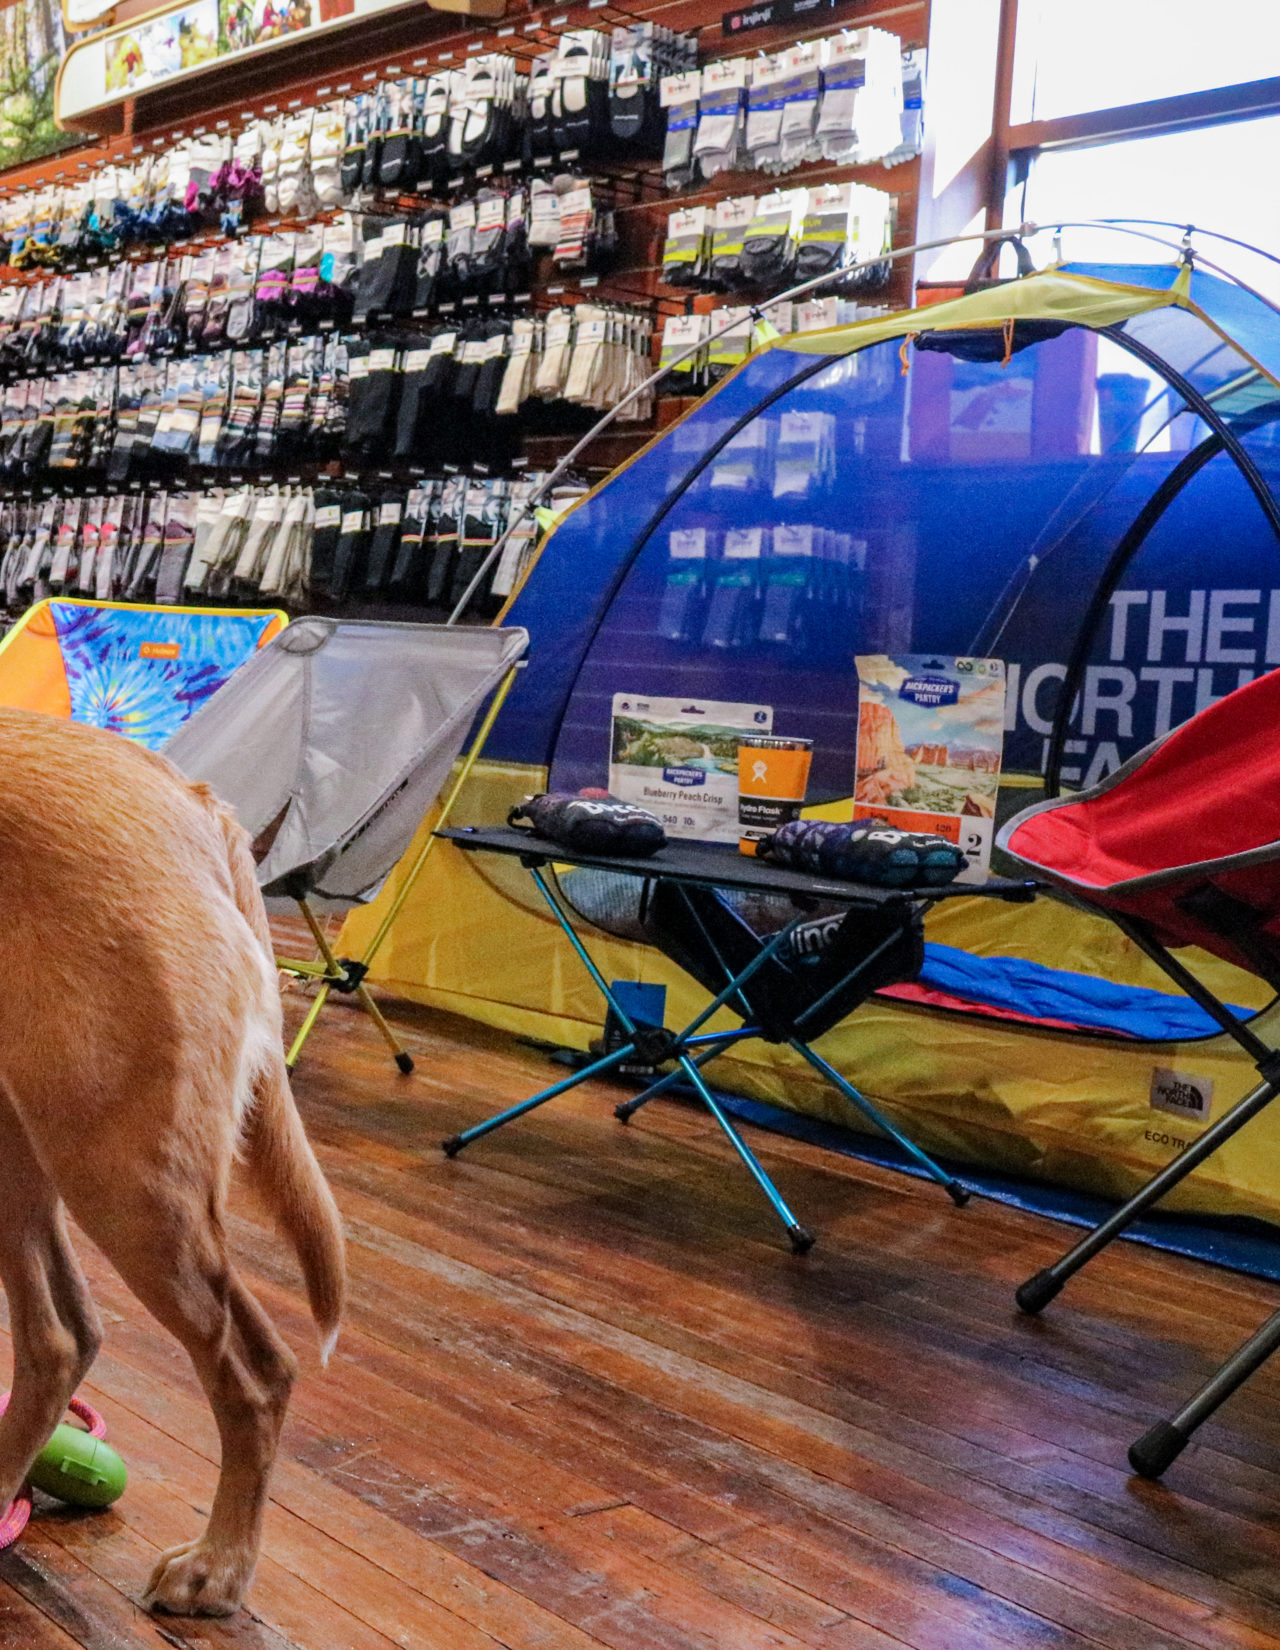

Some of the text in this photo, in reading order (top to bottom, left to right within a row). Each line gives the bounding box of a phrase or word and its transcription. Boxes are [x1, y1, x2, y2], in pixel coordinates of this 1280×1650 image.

[1109, 589, 1261, 663] THE
[643, 786, 723, 805] Blueberry Peach Crisp
[965, 833, 982, 856] 2
[1173, 1081, 1192, 1091] THE
[1144, 1130, 1169, 1144] ECO
